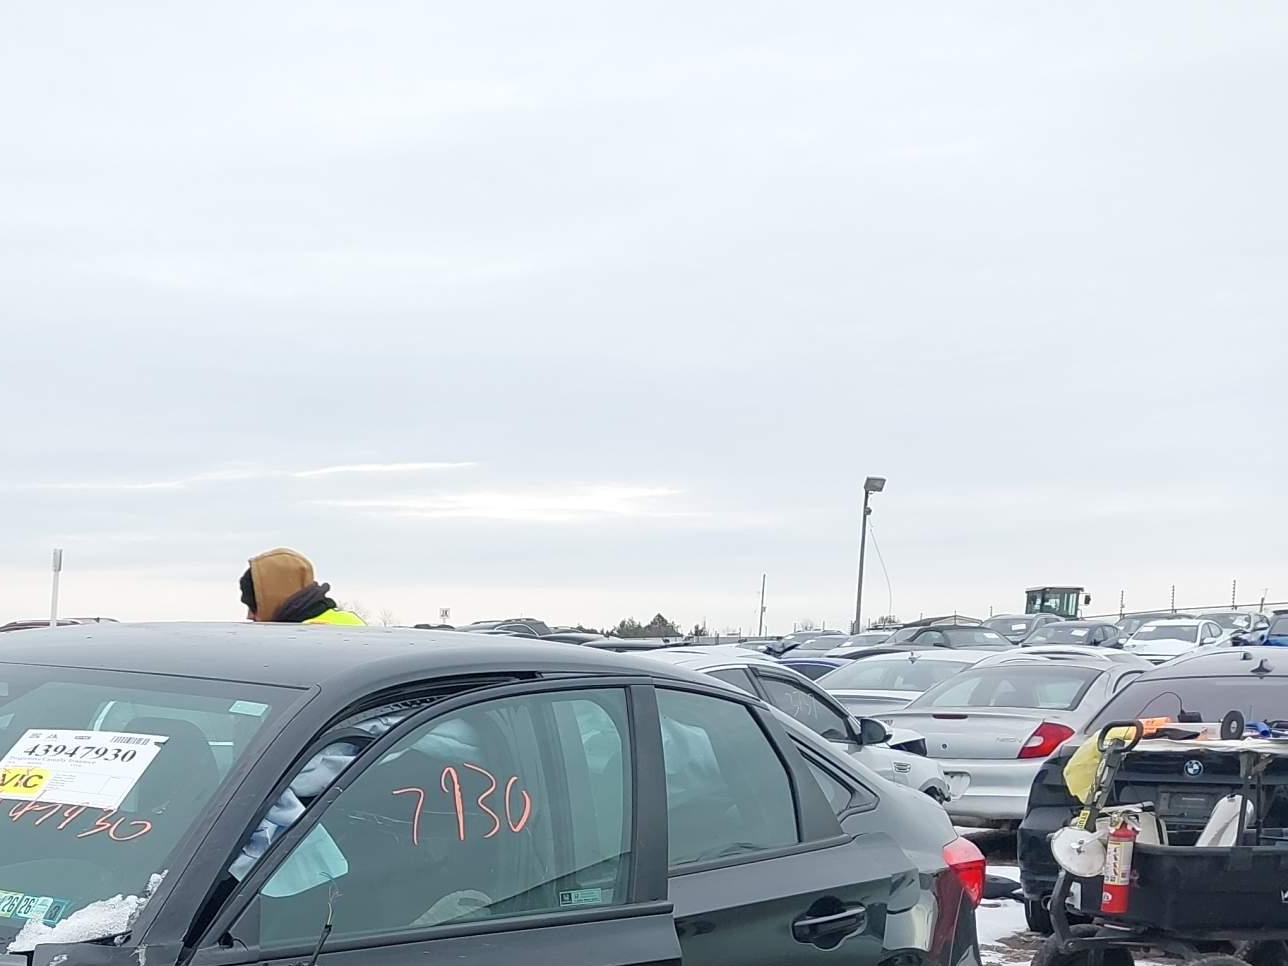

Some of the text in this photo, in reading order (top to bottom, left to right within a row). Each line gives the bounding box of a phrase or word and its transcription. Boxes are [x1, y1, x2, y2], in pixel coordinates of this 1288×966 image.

[24, 744, 137, 763] 43947930
[0, 773, 43, 789] VIC
[392, 762, 532, 845] 7930
[1, 896, 20, 912] 26
[18, 897, 34, 914] 26
